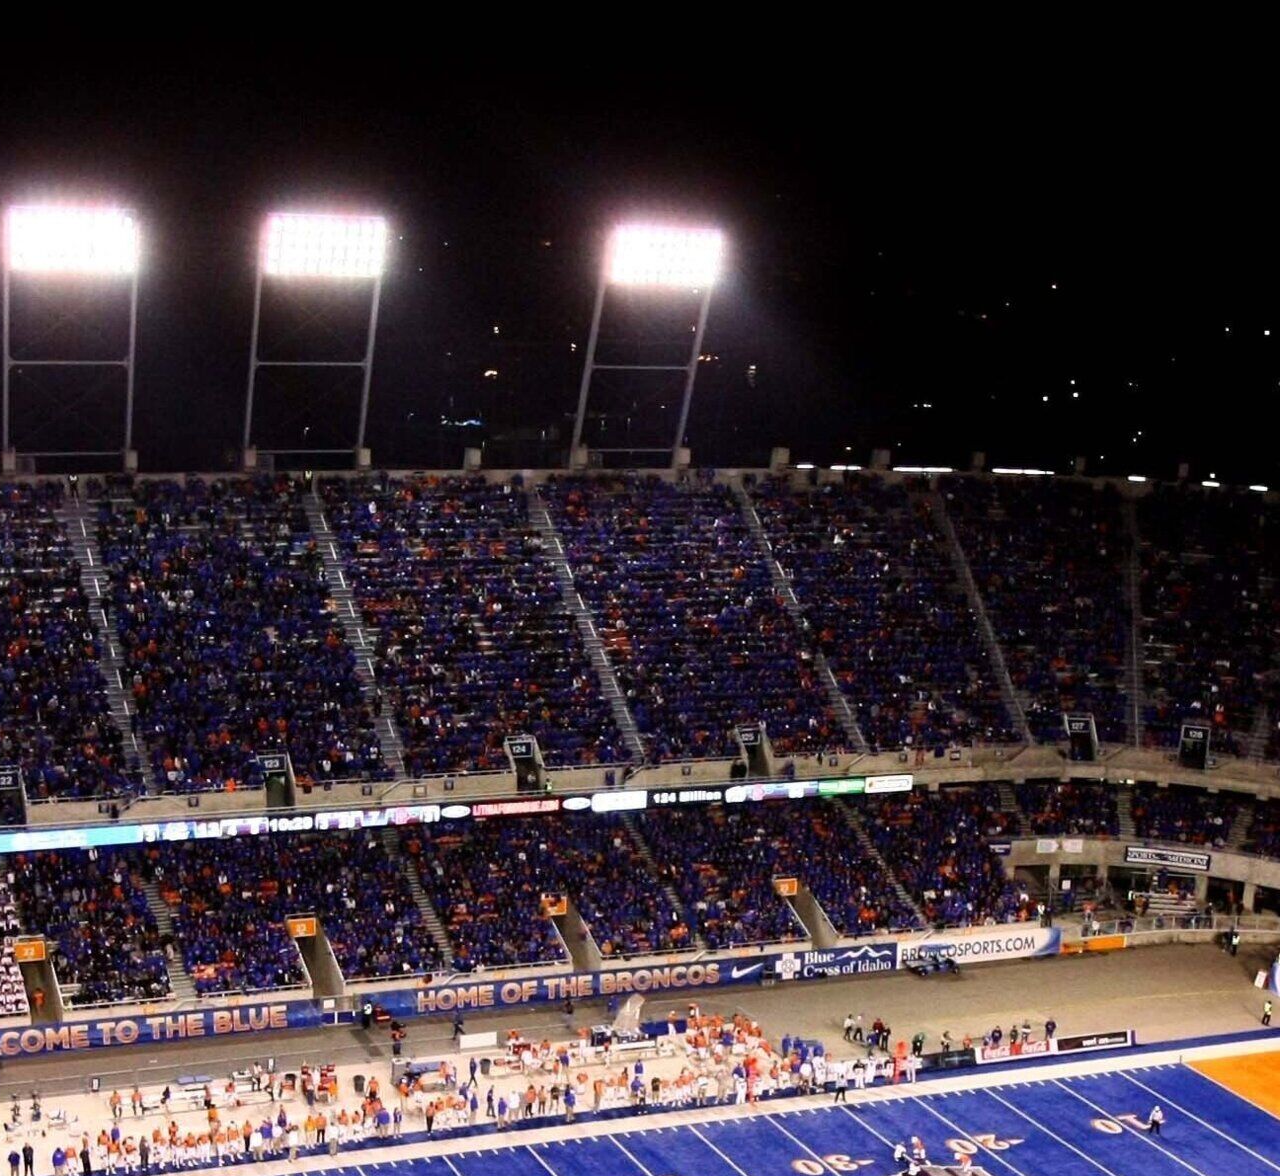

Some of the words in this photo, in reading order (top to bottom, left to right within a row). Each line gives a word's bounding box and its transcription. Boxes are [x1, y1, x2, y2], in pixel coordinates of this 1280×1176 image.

[512, 745, 526, 754] 124
[803, 949, 836, 965] Blue
[841, 960, 855, 974] of
[856, 956, 892, 974] Idaho
[416, 984, 495, 1013] HOME
[500, 980, 538, 1003] OF
[542, 972, 595, 999] THE
[599, 963, 720, 995] BRONCOS
[97, 1020, 139, 1045] TO
[147, 1012, 205, 1041] THE
[213, 1004, 288, 1034] BLUE
[945, 1132, 1011, 1157] 20
[790, 1153, 861, 1176] 30
